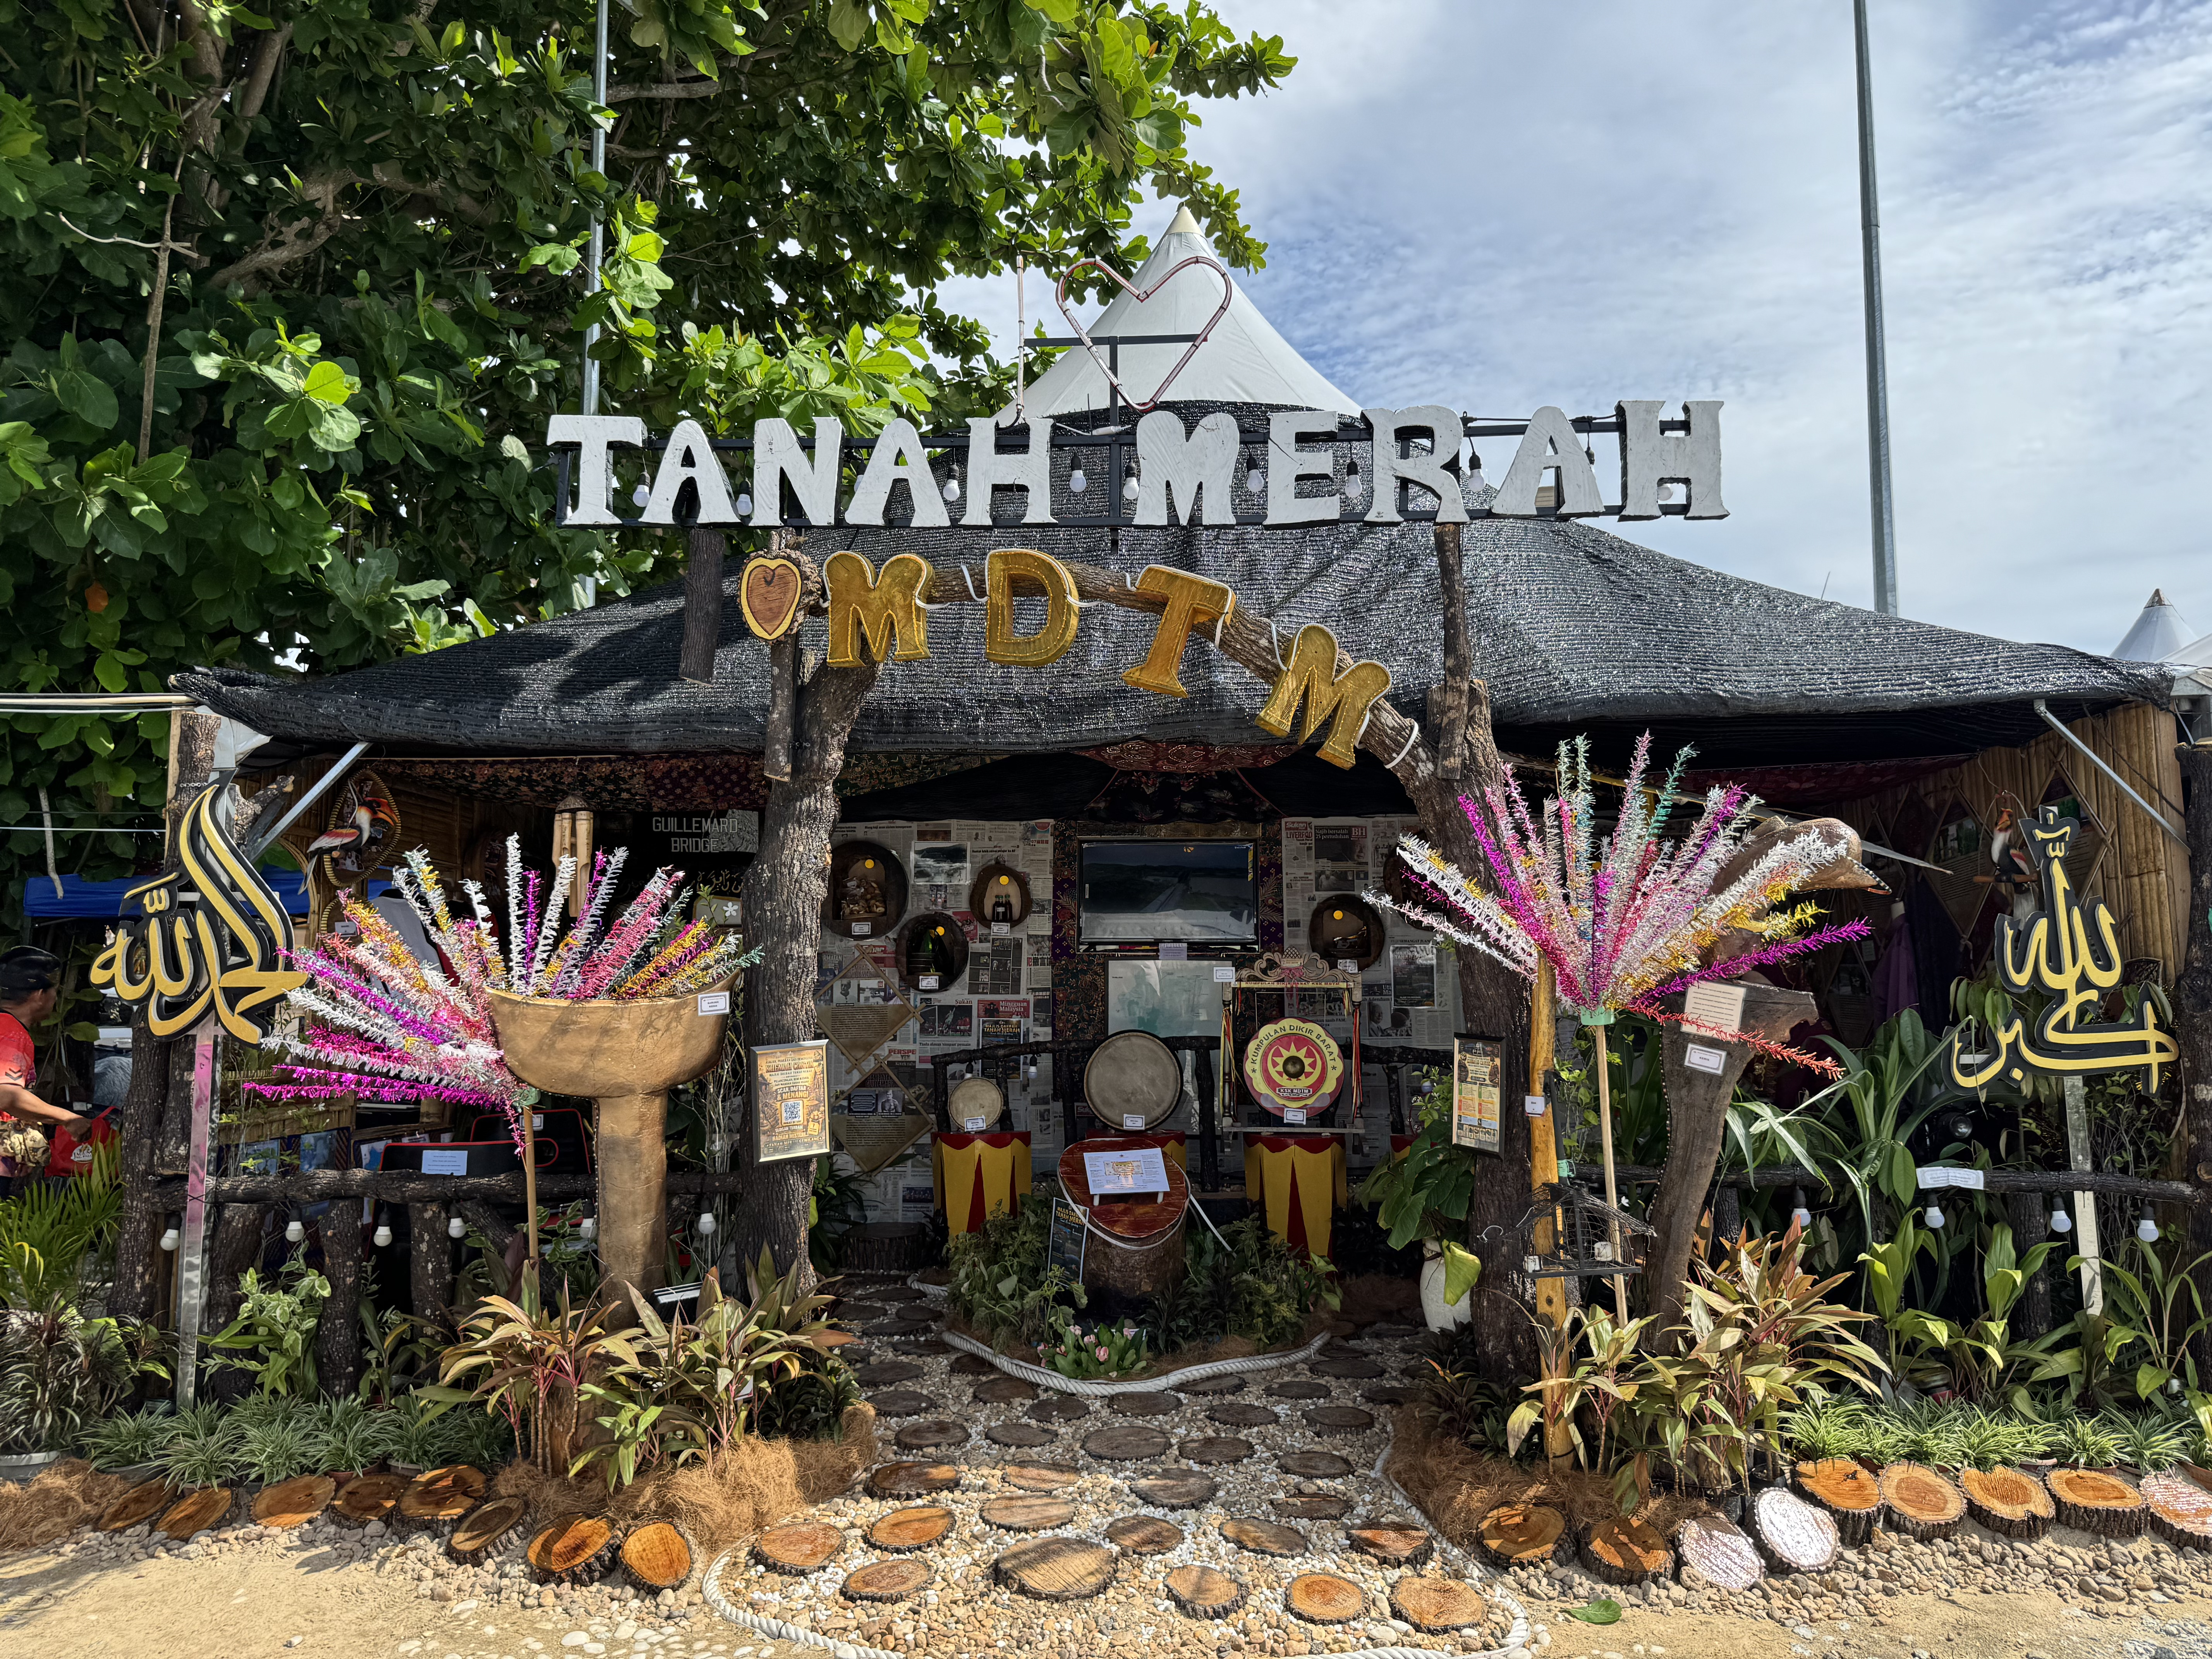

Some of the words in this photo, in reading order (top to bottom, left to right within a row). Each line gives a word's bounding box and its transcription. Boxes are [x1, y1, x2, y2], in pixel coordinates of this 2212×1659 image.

[546, 414, 1056, 527] TANAH
[1134, 400, 1729, 527] MERAH
[653, 817, 738, 833] GUILLEMARD
[1352, 828, 1366, 836] BH
[671, 838, 719, 853] BRIDGE
[1251, 1026, 1286, 1064] KUMPULAN
[1289, 1025, 1314, 1035] DIKIR
[1316, 1034, 1336, 1063] BARAT
[1056, 1211, 1069, 1220] TANAH
